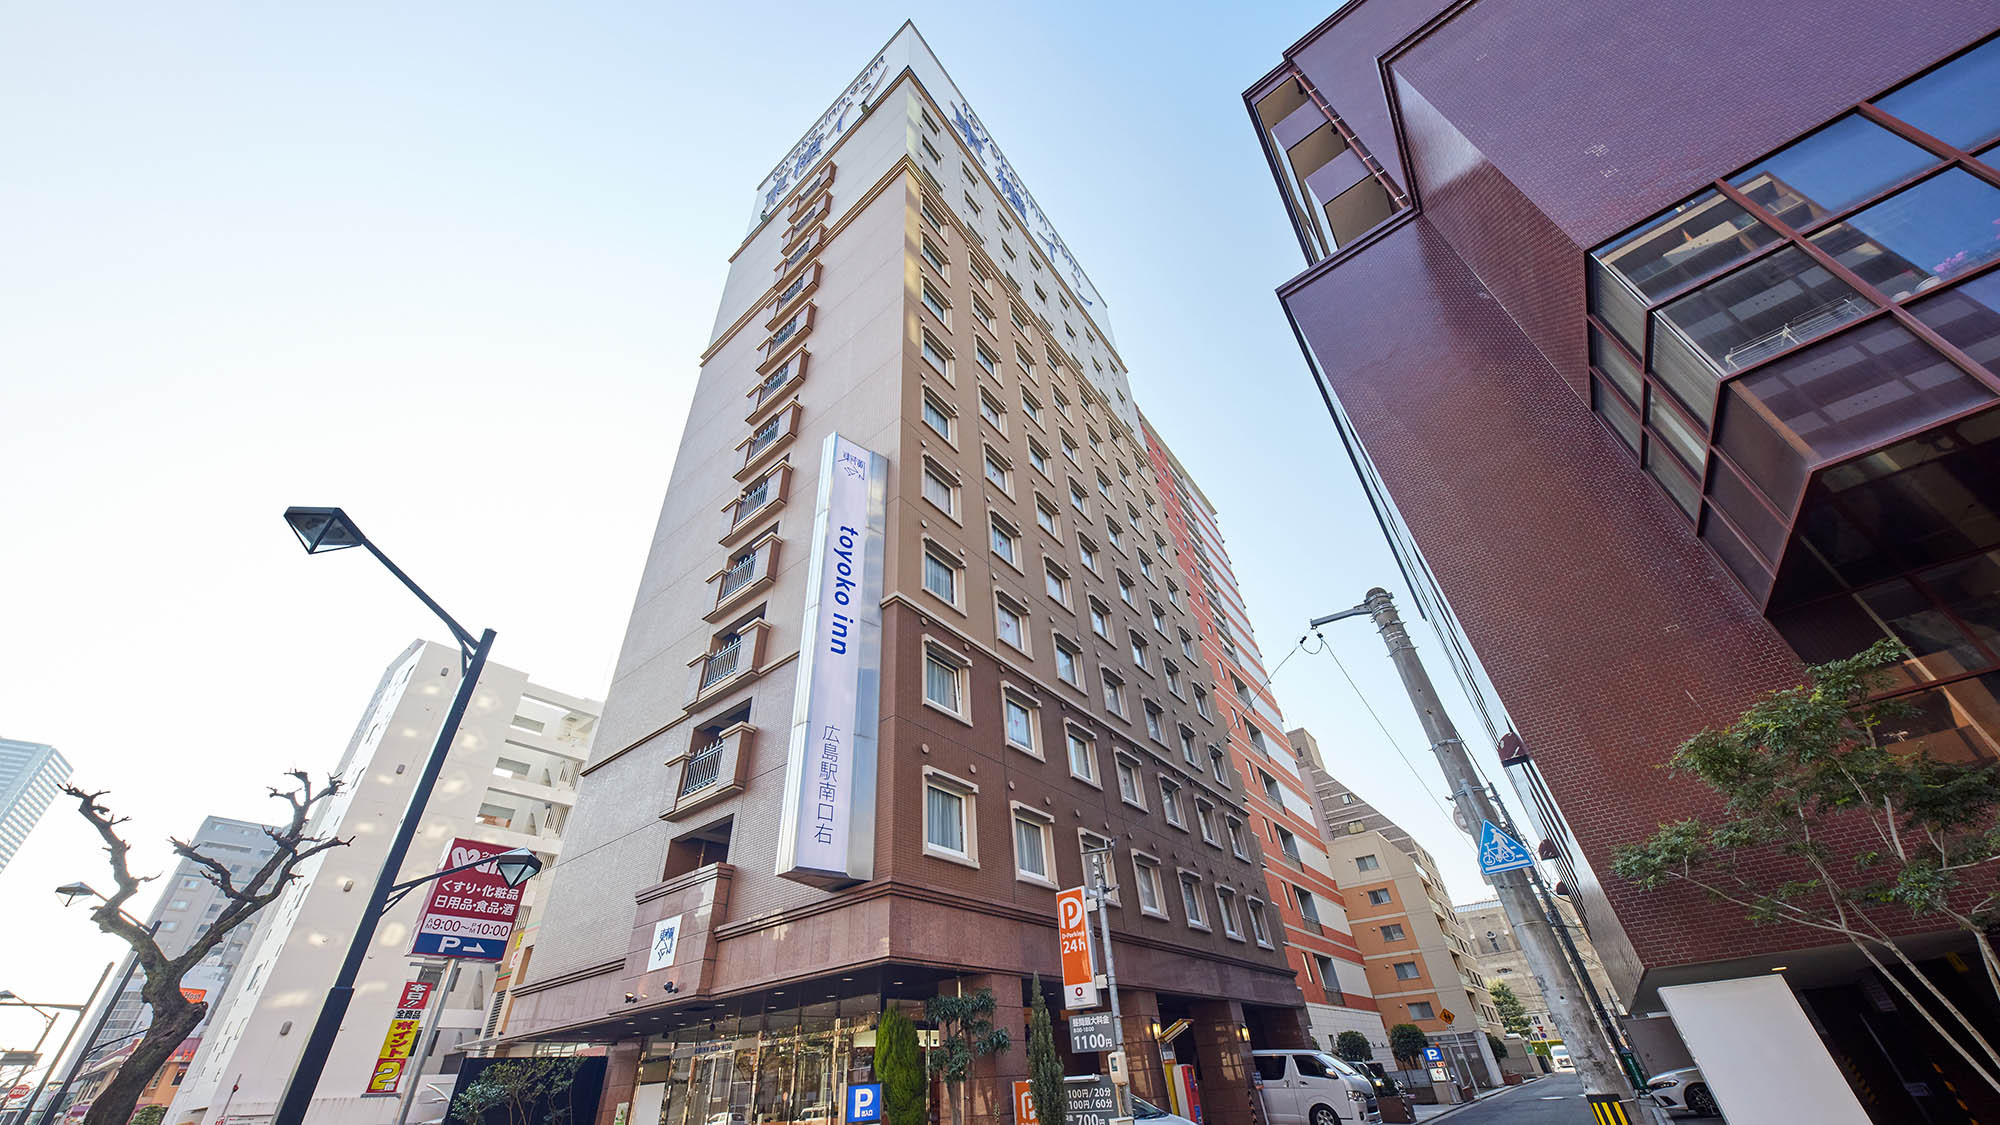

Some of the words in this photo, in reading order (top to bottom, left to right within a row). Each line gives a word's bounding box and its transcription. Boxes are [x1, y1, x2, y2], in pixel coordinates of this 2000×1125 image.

[833, 525, 859, 606] toyoko
[830, 612, 854, 655] inn
[814, 724, 841, 845] 広島駅南口右
[437, 936, 461, 953] P
[1063, 938, 1087, 955] 24h
[395, 1009, 422, 1020] 全商品
[389, 1021, 415, 1058] ポイント
[1074, 1033, 1113, 1050] 1100円
[1067, 1087, 1111, 1099] 100円/20分
[854, 1088, 873, 1118] P
[1068, 1098, 1113, 1110] 100円/60分
